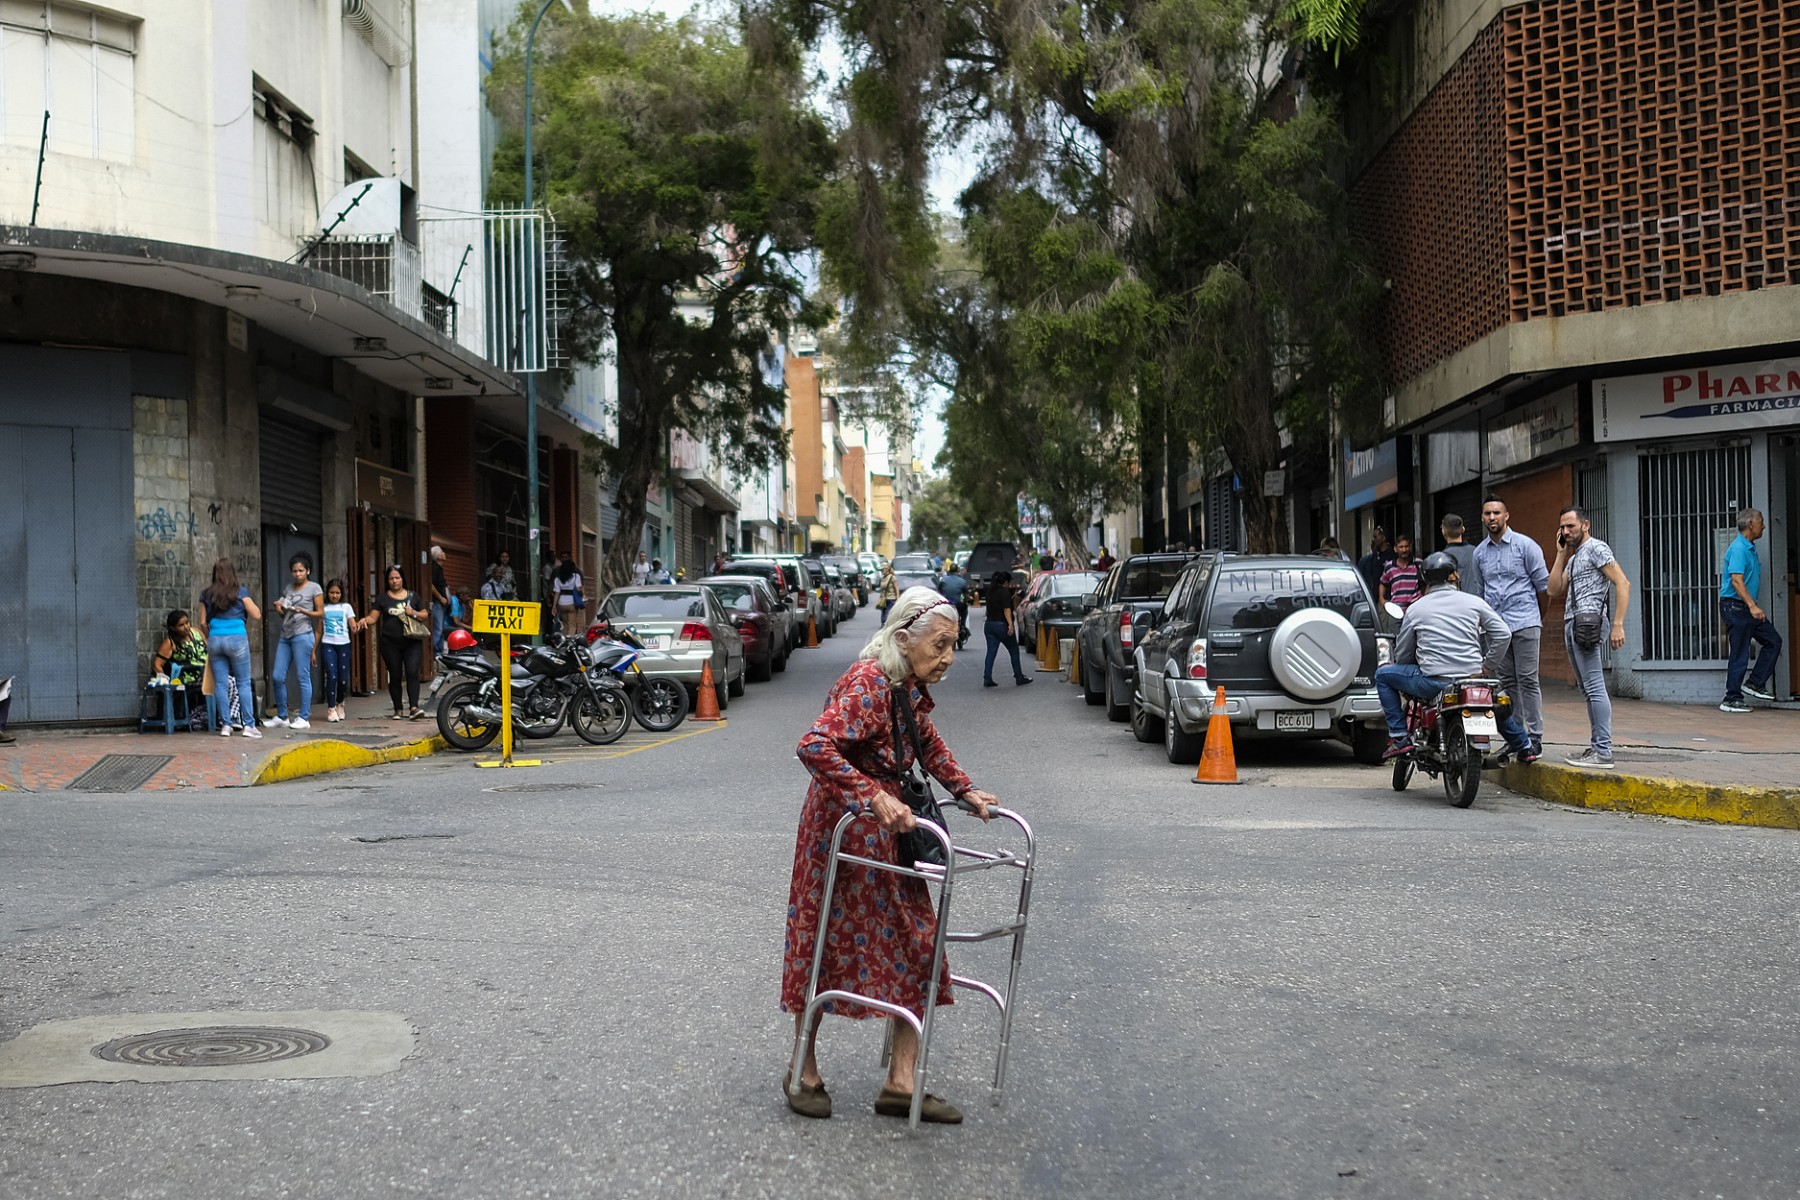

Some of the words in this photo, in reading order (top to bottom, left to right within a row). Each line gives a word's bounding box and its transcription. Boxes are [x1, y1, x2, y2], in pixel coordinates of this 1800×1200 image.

[1710, 397, 1800, 415] FARMACI
[488, 605, 524, 617] MOTO
[488, 616, 522, 629] TAXI
[1278, 715, 1294, 727] BCC
[1296, 715, 1312, 726] 61U
